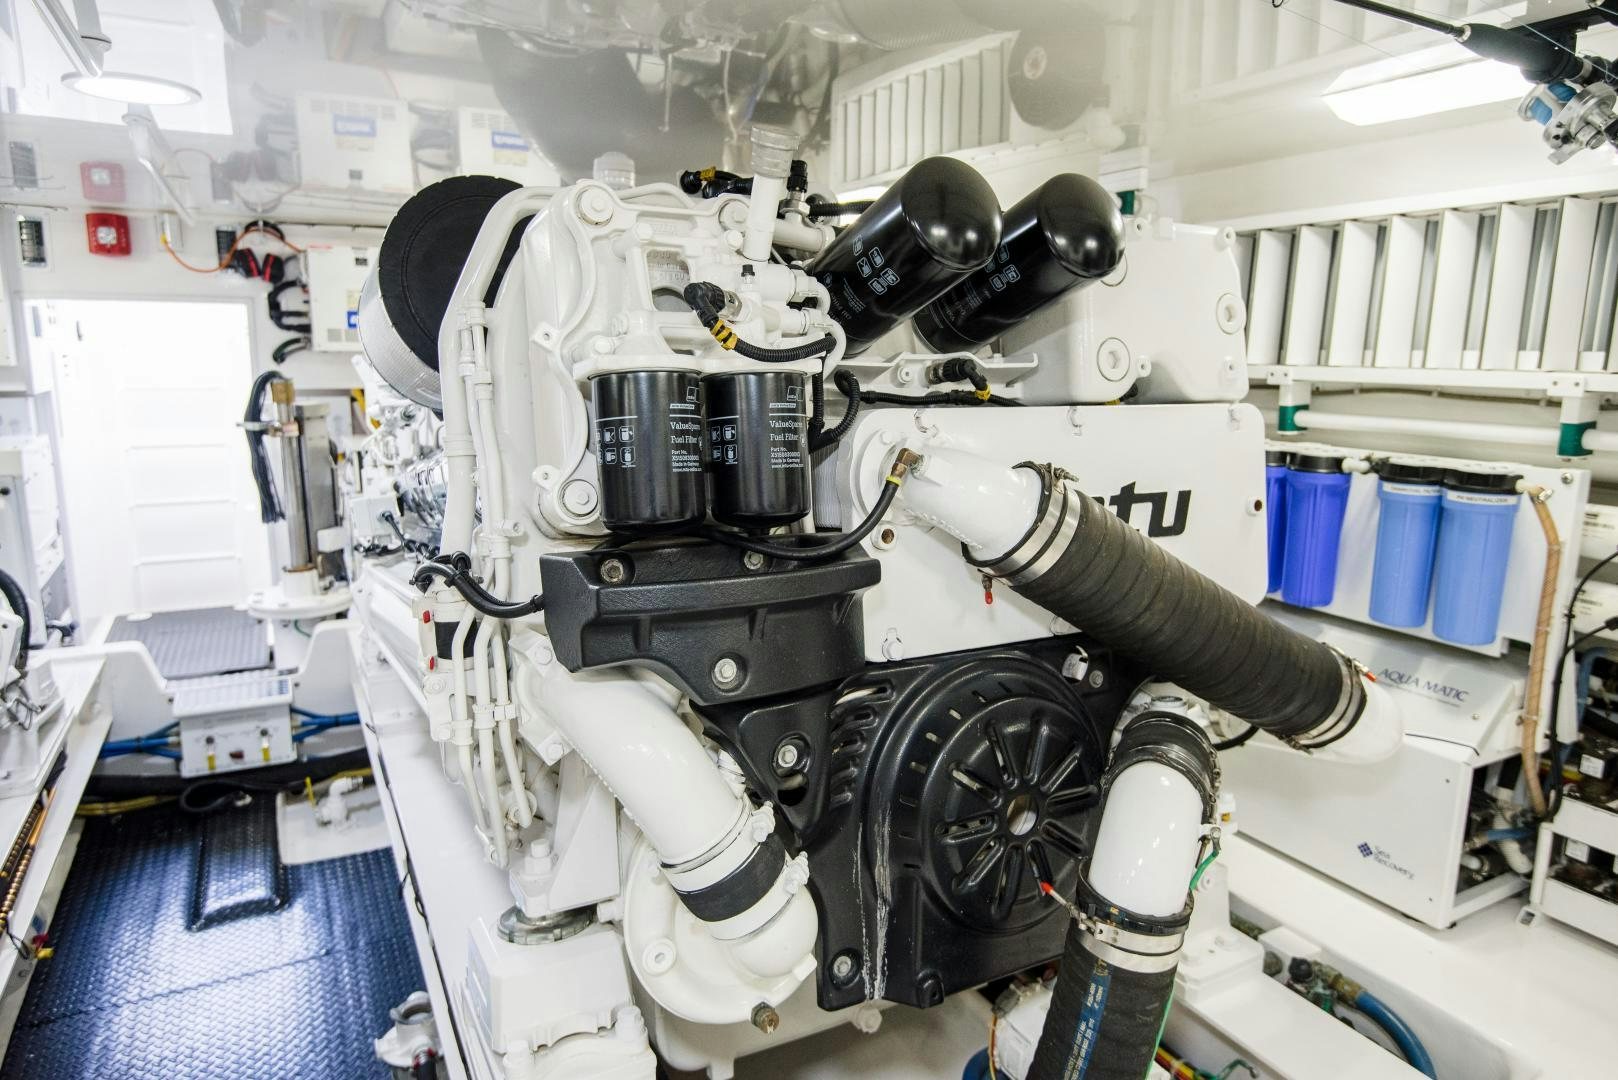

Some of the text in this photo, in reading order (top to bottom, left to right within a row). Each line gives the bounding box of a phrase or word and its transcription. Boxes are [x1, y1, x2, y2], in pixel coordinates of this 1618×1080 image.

[671, 435, 698, 444] Fuel Filter
[770, 433, 799, 441] Fuel Filter
[1091, 481, 1191, 537] tu
[1378, 671, 1469, 702] AQUA MATIC
